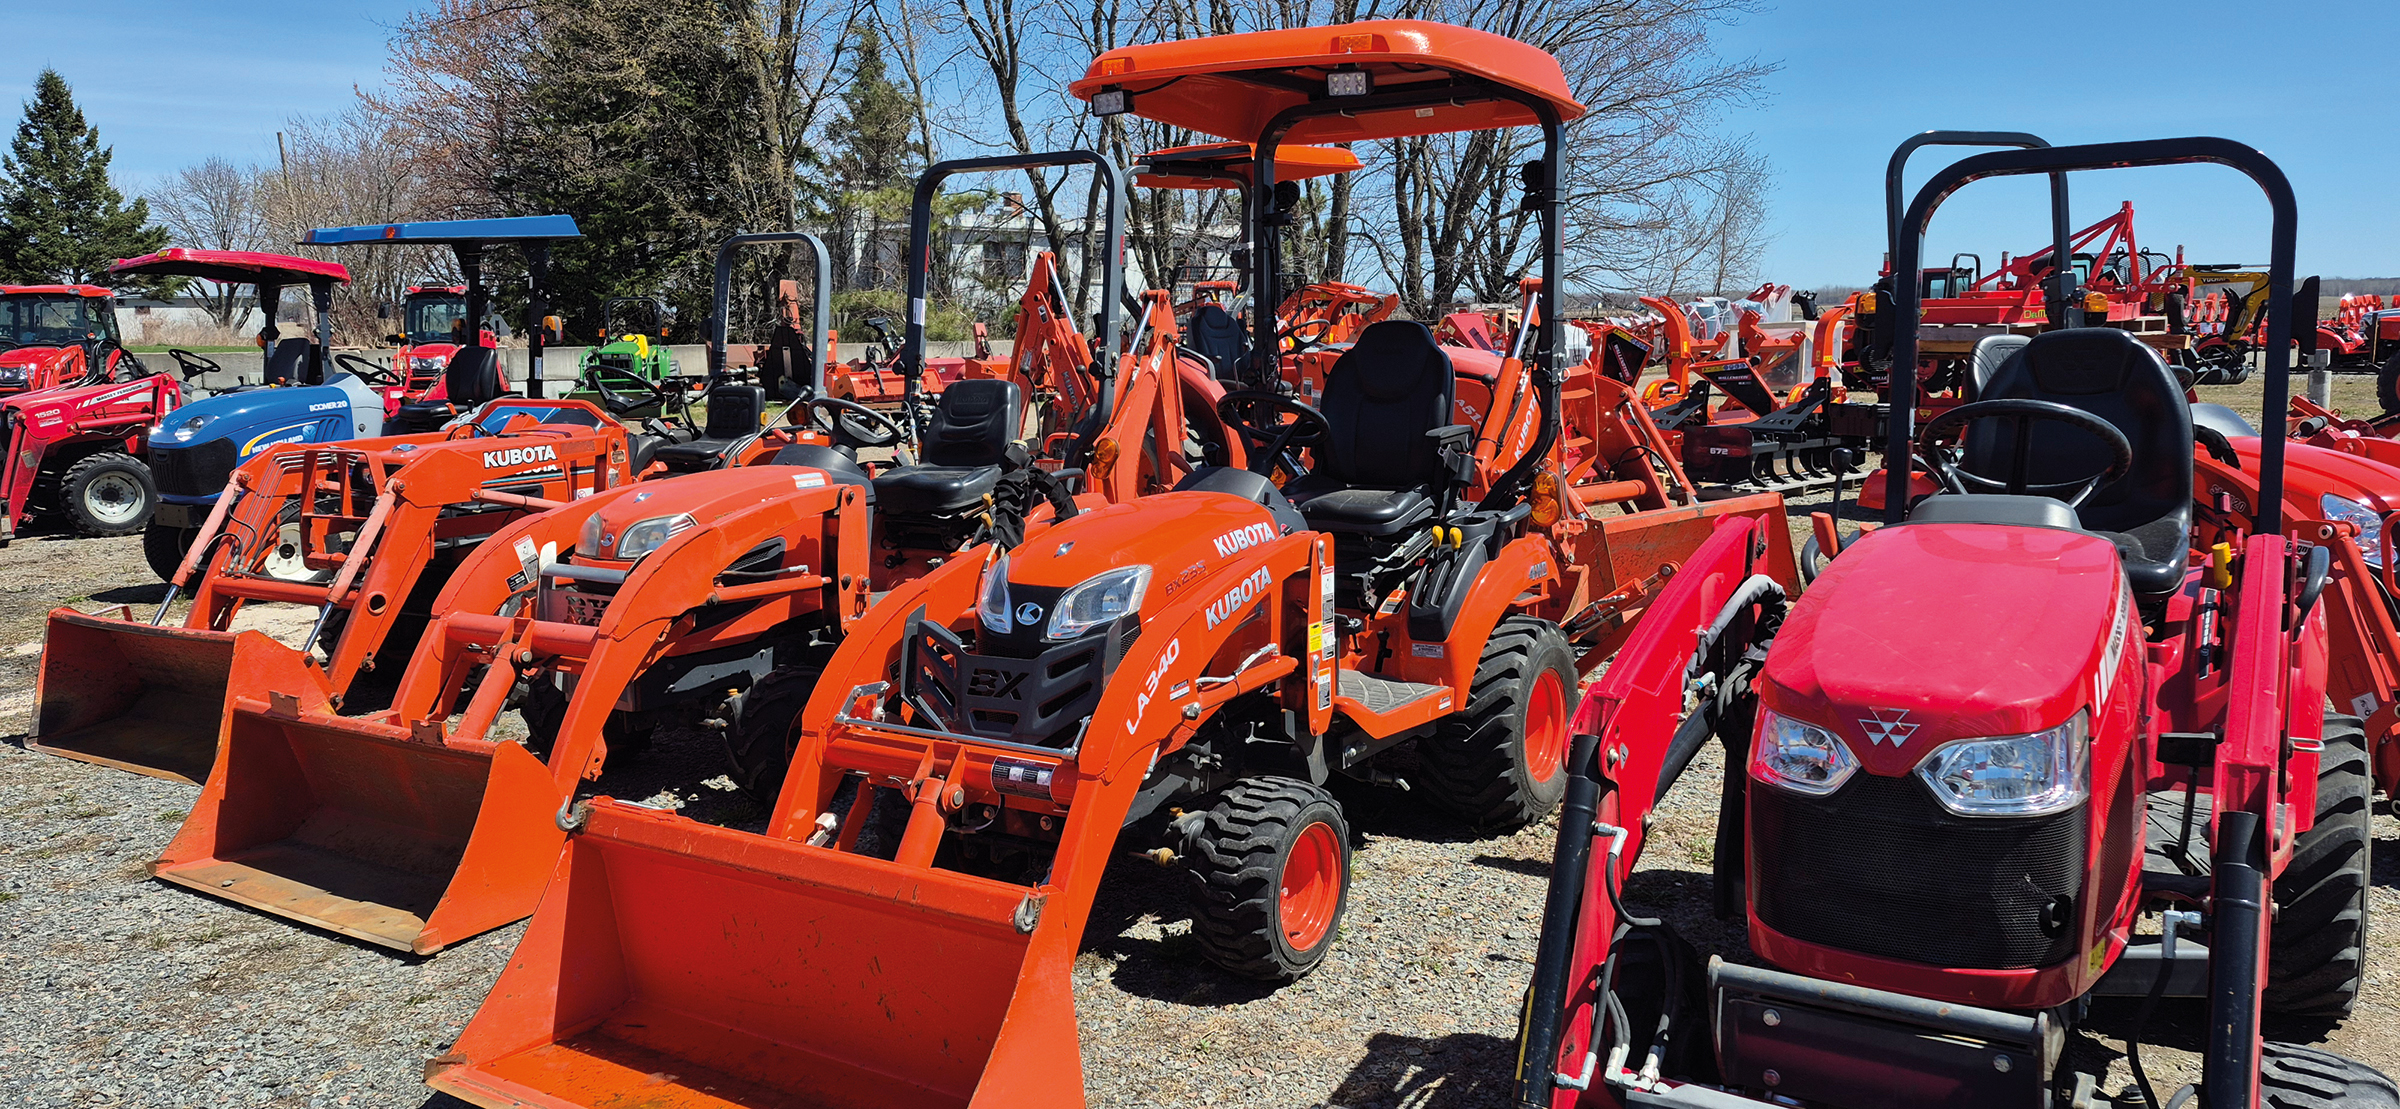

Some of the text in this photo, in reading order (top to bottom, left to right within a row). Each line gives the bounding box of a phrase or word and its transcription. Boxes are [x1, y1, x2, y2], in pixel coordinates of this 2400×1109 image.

[34, 408, 61, 419] 1520
[337, 400, 348, 408] 20
[483, 444, 558, 469] KUBOTA
[1213, 521, 1276, 560] KUBOTA
[1205, 563, 1273, 632] KUBOTA
[966, 667, 1030, 701] BX
[1126, 637, 1180, 735] LA340
